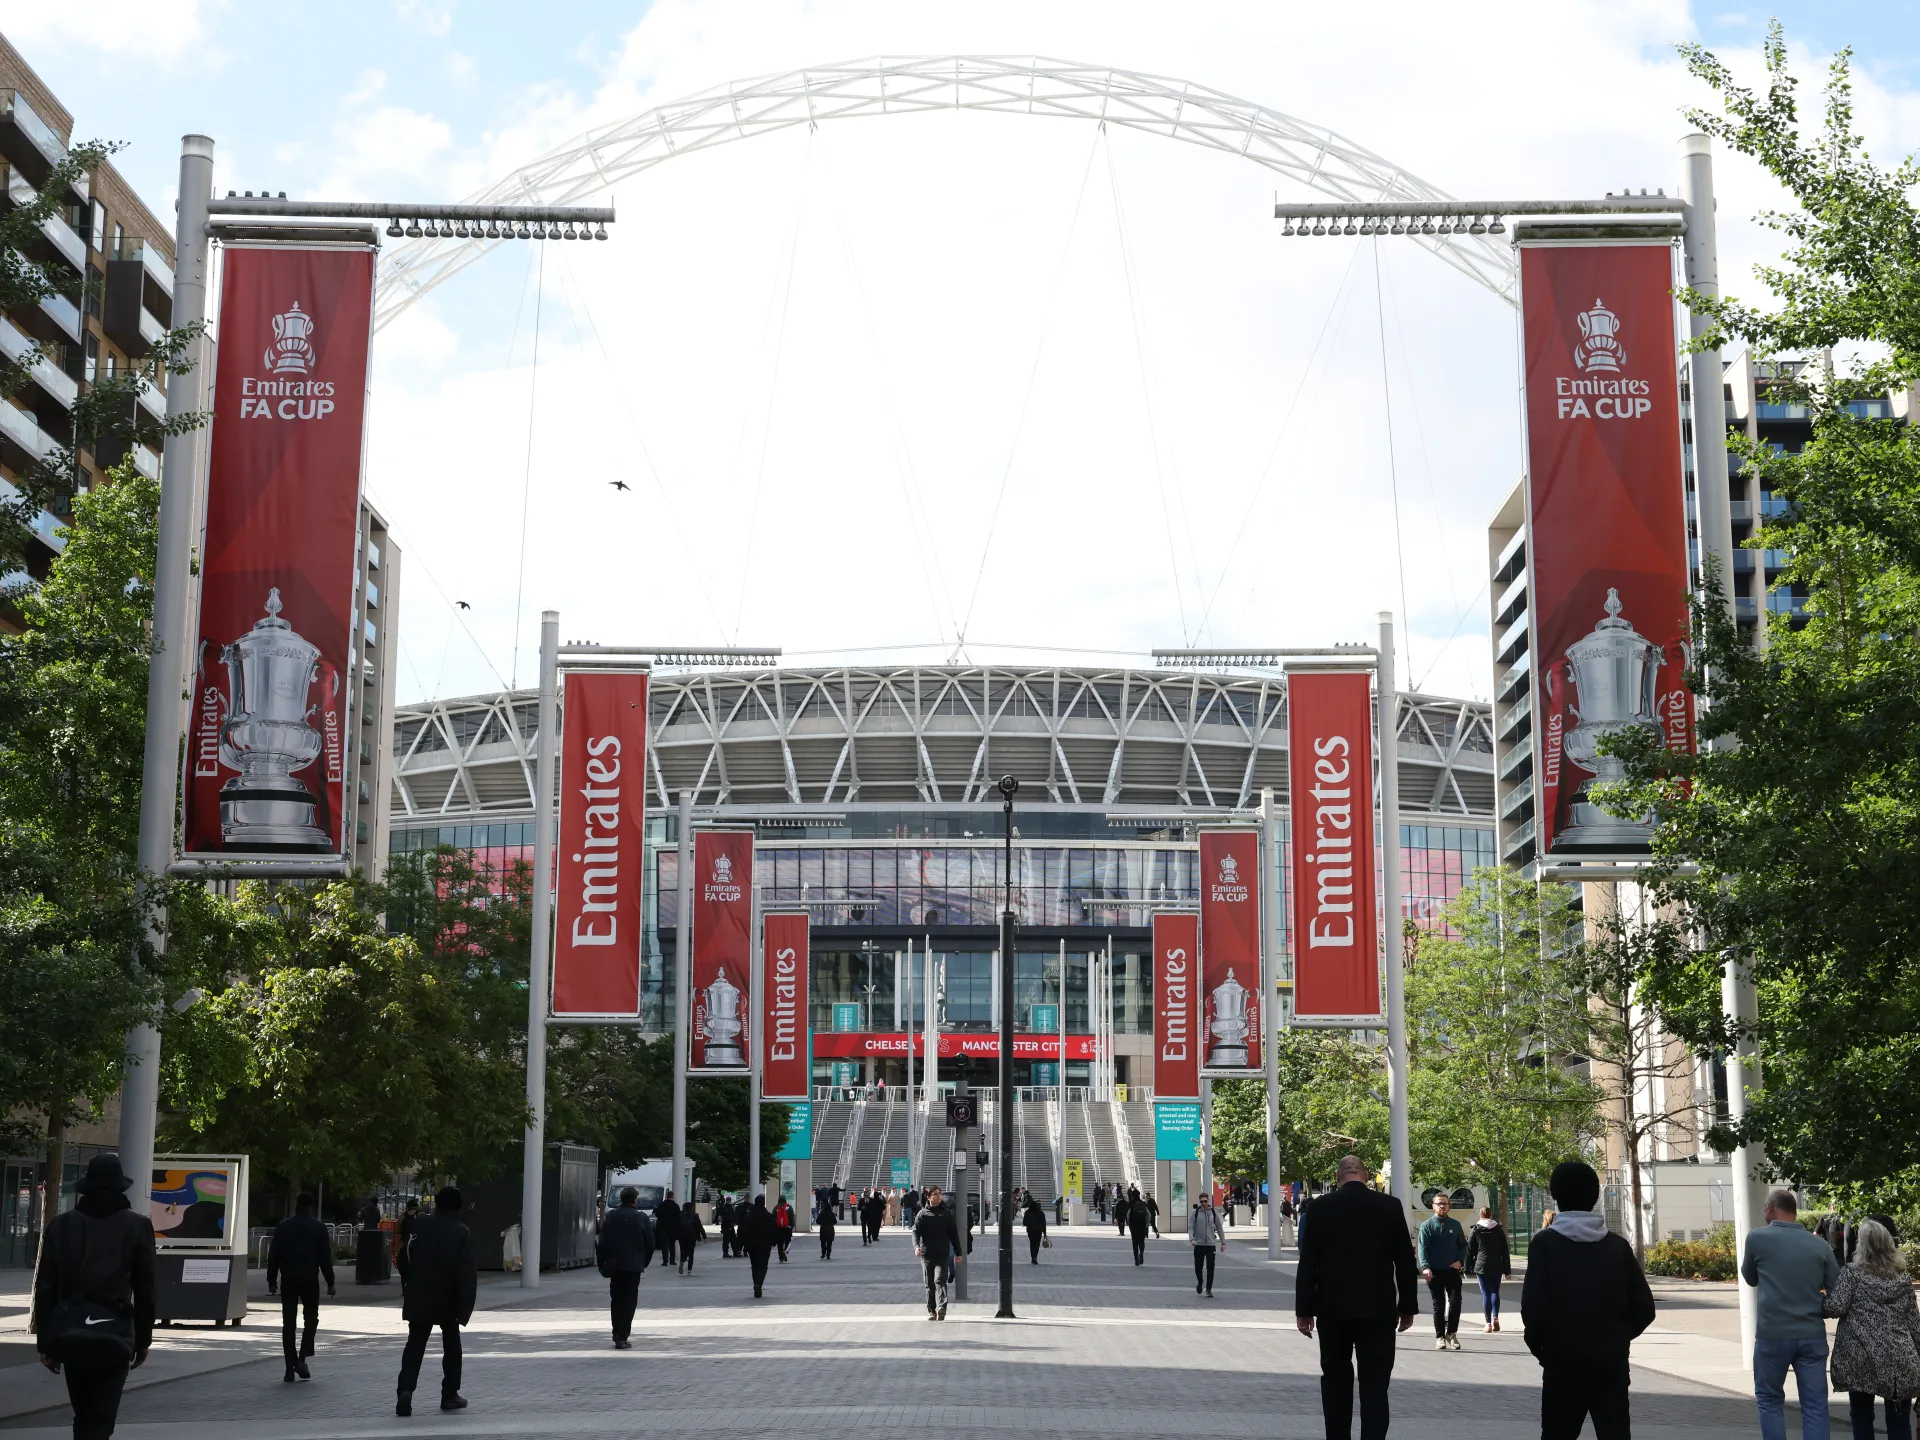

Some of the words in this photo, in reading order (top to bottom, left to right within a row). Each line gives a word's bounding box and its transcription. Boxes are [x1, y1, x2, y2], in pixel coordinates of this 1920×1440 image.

[241, 377, 334, 396] Emirates
[1555, 376, 1650, 396] Emirates
[240, 399, 273, 420] FA
[278, 399, 335, 420] CUP
[1557, 397, 1591, 420] FA
[1594, 397, 1652, 420] CUP
[195, 686, 219, 778] Emirates
[324, 711, 342, 783] Emirates
[1665, 689, 1687, 784] irates
[1543, 713, 1563, 787] Emirates
[571, 735, 622, 949] Emirates
[1305, 735, 1354, 950] Emirates
[704, 883, 741, 893] Emirates
[704, 893, 718, 902] FA
[719, 893, 741, 902] CUP
[1211, 884, 1248, 893] Emirates
[1211, 893, 1225, 902] FA
[1226, 893, 1248, 902] CUP
[770, 947, 796, 1062] Emirates
[1160, 947, 1187, 1062] Emirates
[694, 1004, 704, 1041] Emirates
[1203, 1014, 1212, 1044] Emirates
[1248, 1005, 1258, 1043] Emirates
[962, 1041, 1039, 1051] MANCSTER
